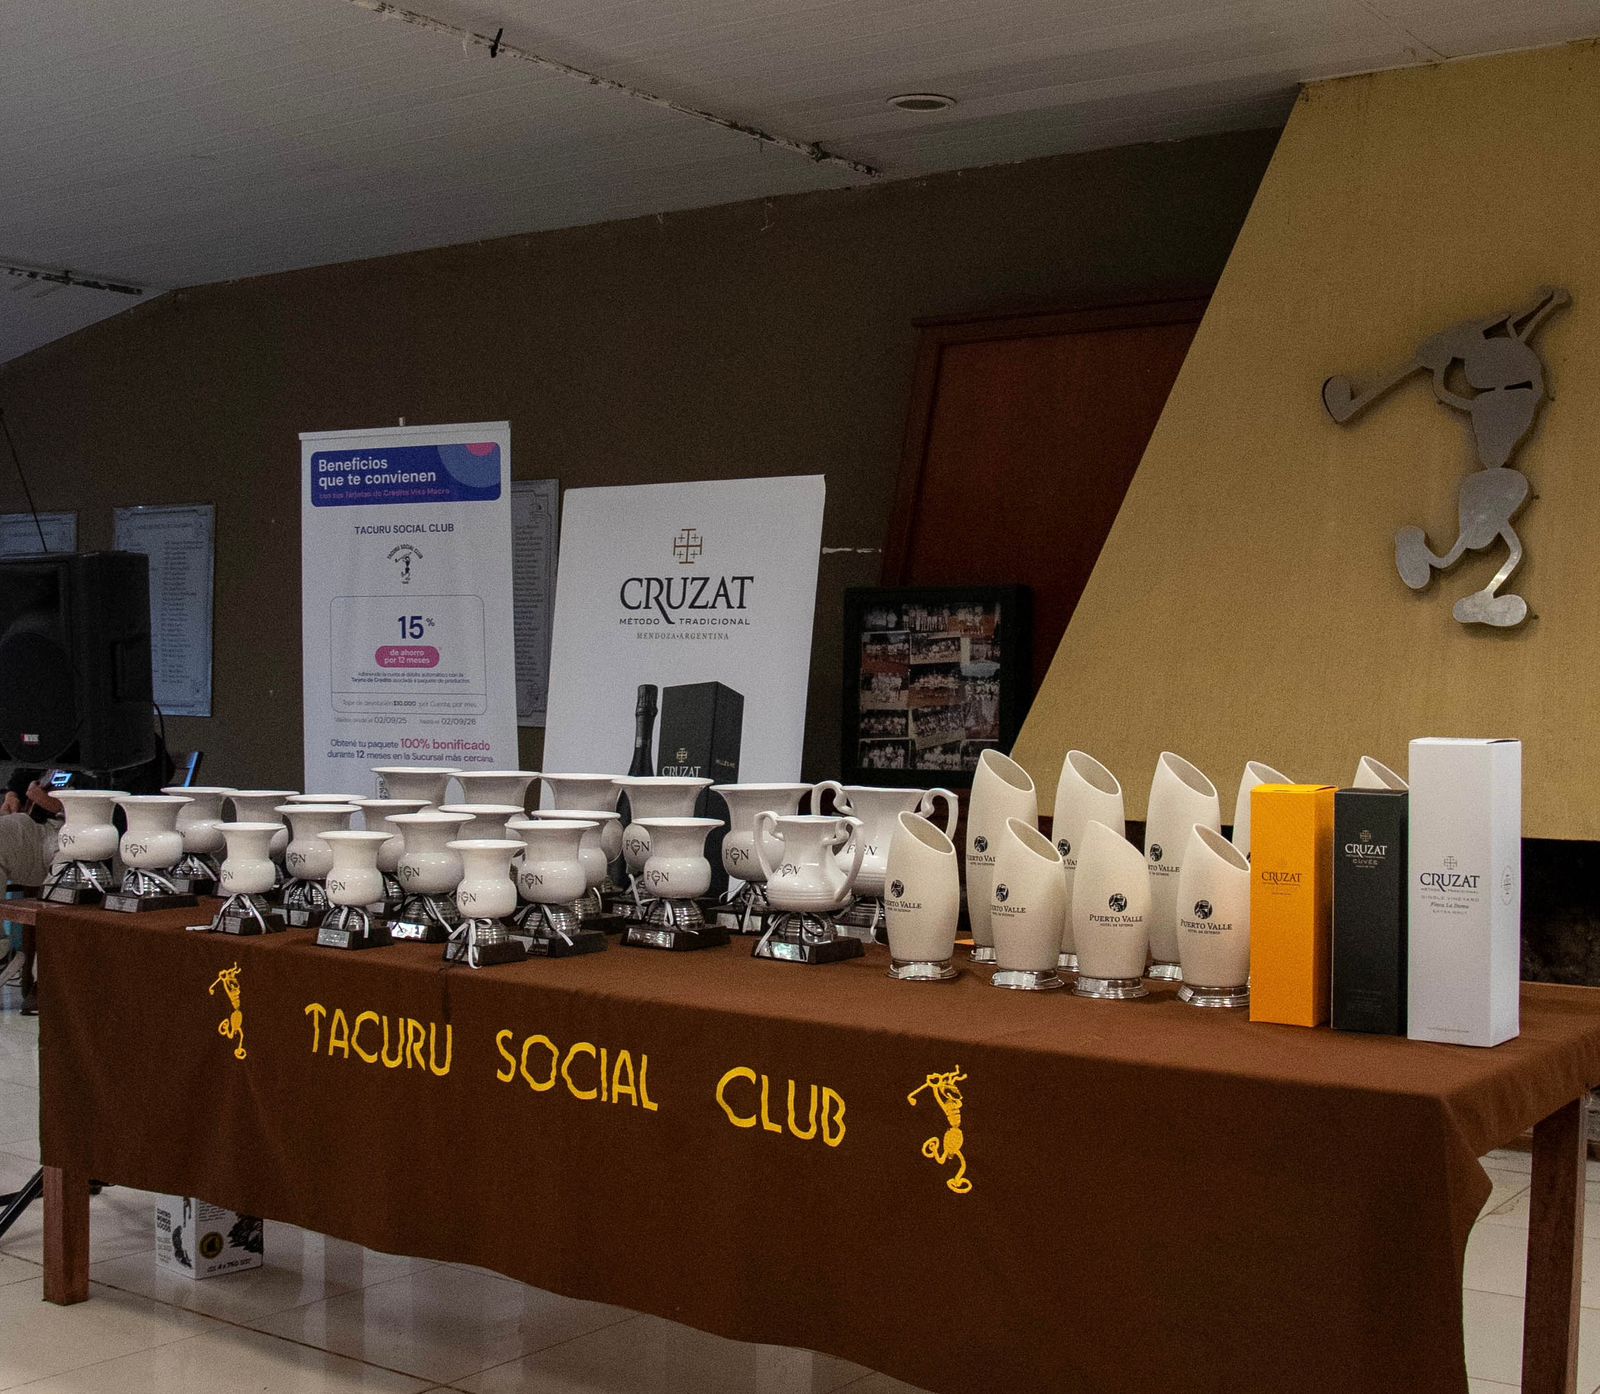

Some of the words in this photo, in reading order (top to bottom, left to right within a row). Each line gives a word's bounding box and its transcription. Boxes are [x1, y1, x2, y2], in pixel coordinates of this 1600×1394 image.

[318, 456, 388, 472] Beneficios
[318, 474, 345, 489] que
[347, 473, 361, 485] te
[365, 470, 436, 484] convienen
[354, 525, 392, 535] TACURU
[393, 524, 427, 534] SOCIAL
[428, 523, 455, 533] CLUB
[619, 576, 754, 625] CRUZAT
[619, 615, 660, 625] MÉTODO
[679, 616, 751, 626] TRADICIONAL
[389, 648, 399, 656] de
[400, 648, 425, 656] ahorro
[384, 657, 397, 665] por
[397, 656, 406, 664] 12
[406, 657, 430, 665] meses
[358, 740, 367, 748] tu
[367, 740, 399, 750] paquete
[400, 738, 430, 749] 100%
[432, 738, 491, 751] bonificado
[327, 750, 355, 759] durante
[356, 750, 365, 758] 12
[366, 752, 391, 760] meses
[404, 752, 411, 760] la
[411, 752, 444, 761] Sucursal
[59, 833, 76, 848] GN
[624, 839, 650, 856] FGN
[124, 844, 148, 858] FGN
[725, 847, 749, 865] FGN
[846, 843, 878, 856] FN
[1344, 843, 1388, 858] CRUZAT
[287, 852, 307, 867] FGN
[221, 869, 234, 882] GN
[399, 865, 420, 881] FGN
[777, 863, 803, 878] FGN
[1158, 864, 1180, 873] VALLE
[520, 872, 543, 889] FGN
[646, 870, 669, 886] FGN
[1261, 871, 1303, 885] CRUZAT
[1420, 872, 1480, 892] CRUZAT
[900, 900, 922, 909] VALLE
[1003, 905, 1027, 913] VALLE
[1089, 914, 1120, 923] PUERTO
[1180, 918, 1206, 929] PUERTO
[1207, 922, 1233, 931] VALLE
[304, 1002, 452, 1076] TACURU
[495, 1029, 659, 1112] SOCIAL
[715, 1066, 846, 1148] CLUB
